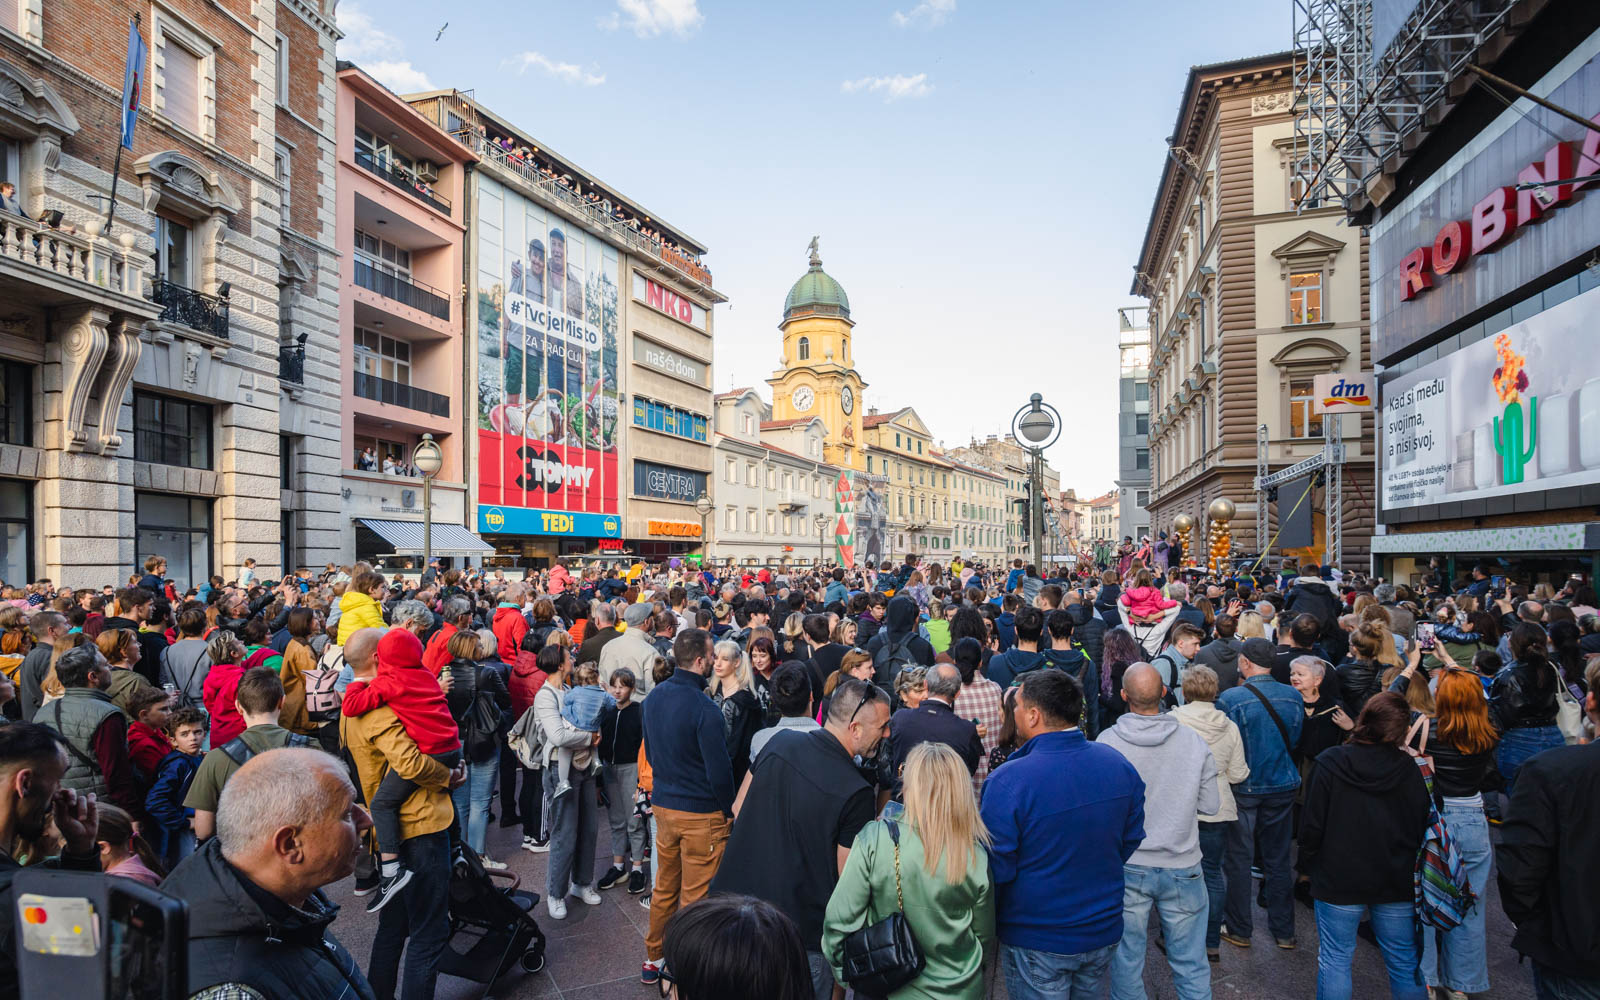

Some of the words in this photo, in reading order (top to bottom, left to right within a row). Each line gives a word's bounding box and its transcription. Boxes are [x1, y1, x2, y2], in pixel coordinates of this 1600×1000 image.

[648, 279, 692, 324] NKD
[526, 335, 538, 349] ZA
[646, 349, 665, 368] naš
[676, 359, 696, 379] dom
[1330, 379, 1365, 397] dm
[1389, 391, 1405, 412] Kad
[1407, 388, 1414, 405] si
[1416, 378, 1444, 402] među
[1389, 412, 1425, 434] svojima,
[1389, 444, 1394, 456] a
[1396, 436, 1411, 455] nisi
[1413, 430, 1435, 451] svoj.
[531, 458, 594, 488] TOMMY
[648, 471, 695, 496] CENTRA
[485, 514, 504, 525] TEDi
[541, 513, 574, 533] TEDi
[604, 521, 617, 531] TEDi
[648, 520, 702, 537] KORZO
[598, 538, 624, 550] TOMMY
